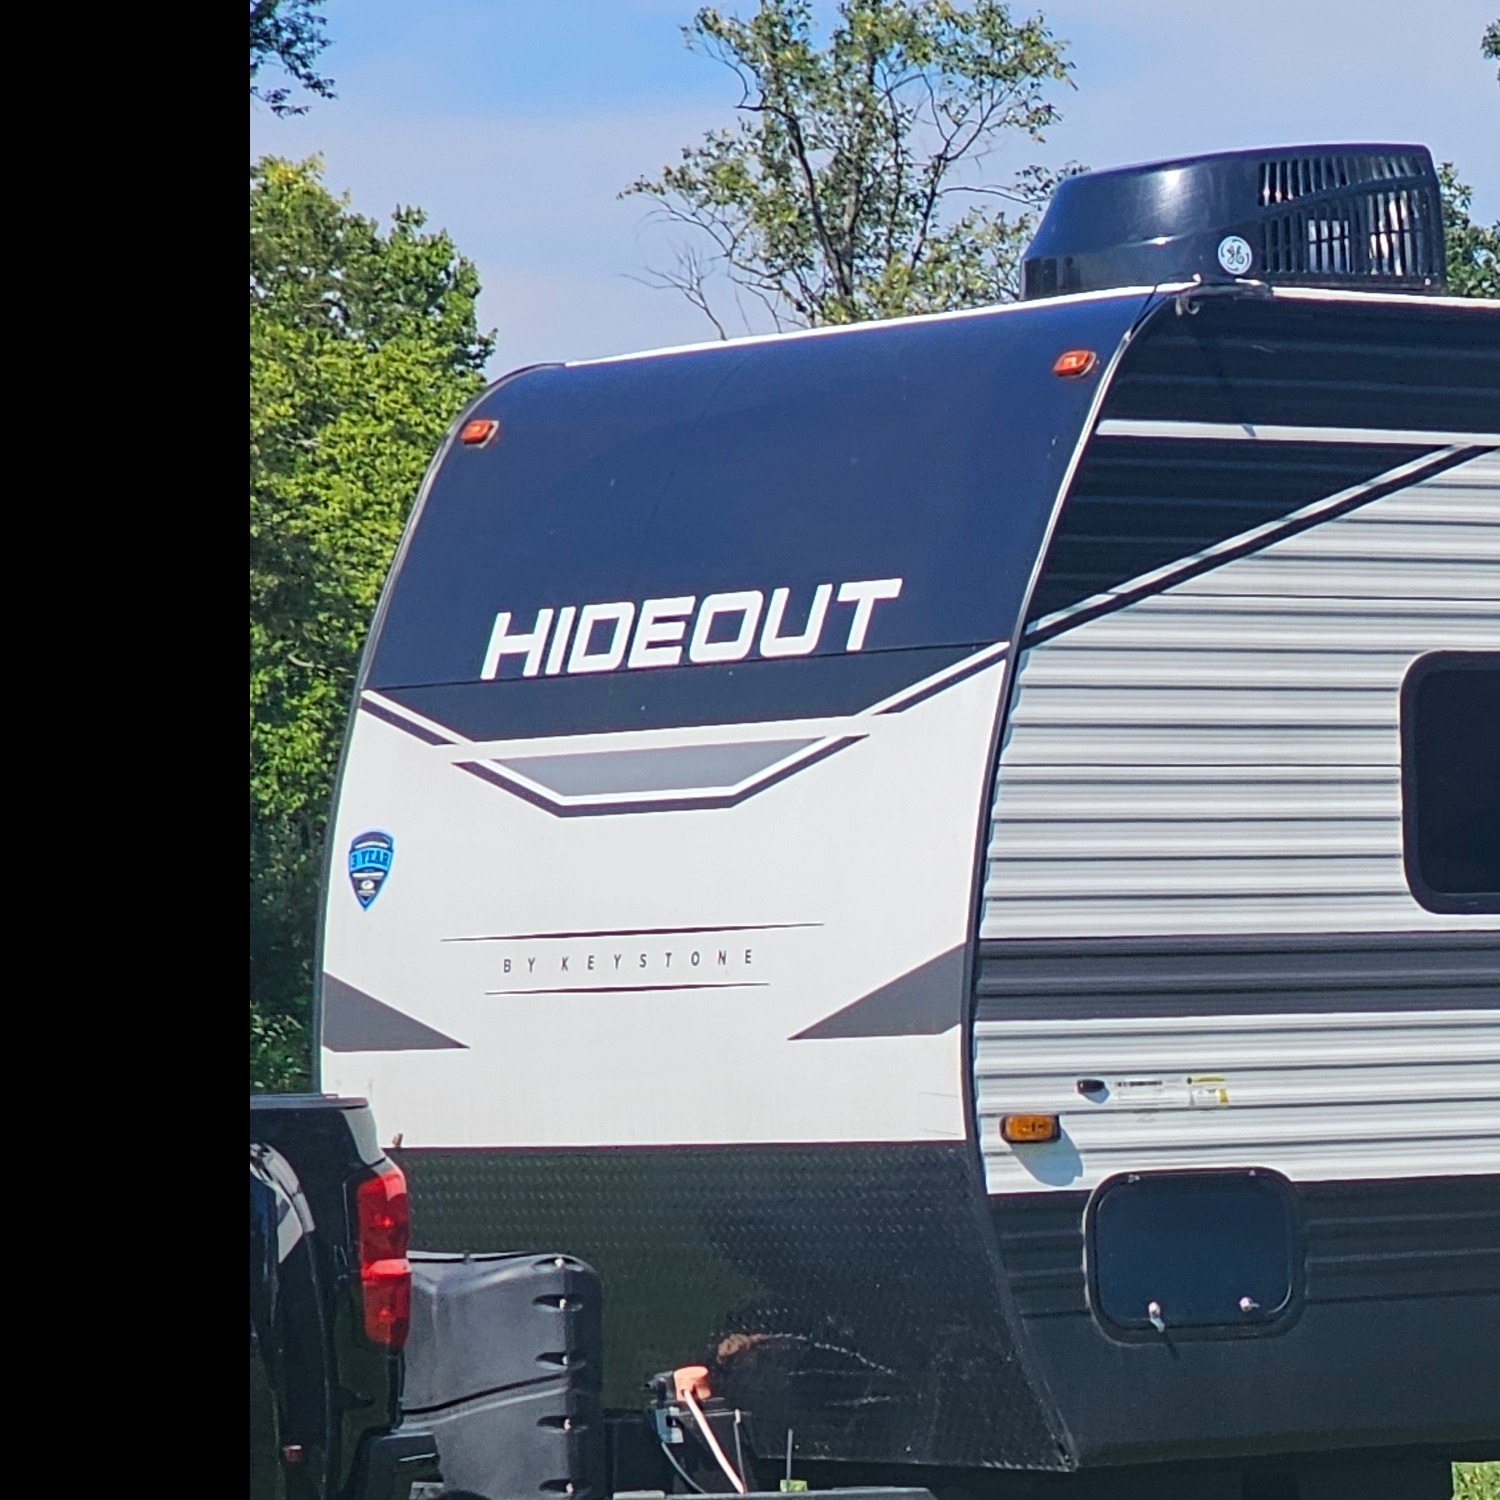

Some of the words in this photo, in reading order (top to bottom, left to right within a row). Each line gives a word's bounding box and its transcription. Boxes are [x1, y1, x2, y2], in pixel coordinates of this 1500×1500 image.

[480, 578, 902, 681] HIDEOUT
[360, 849, 389, 867] YEAR
[503, 958, 535, 973] BY
[560, 949, 752, 971] KEYSTONE
